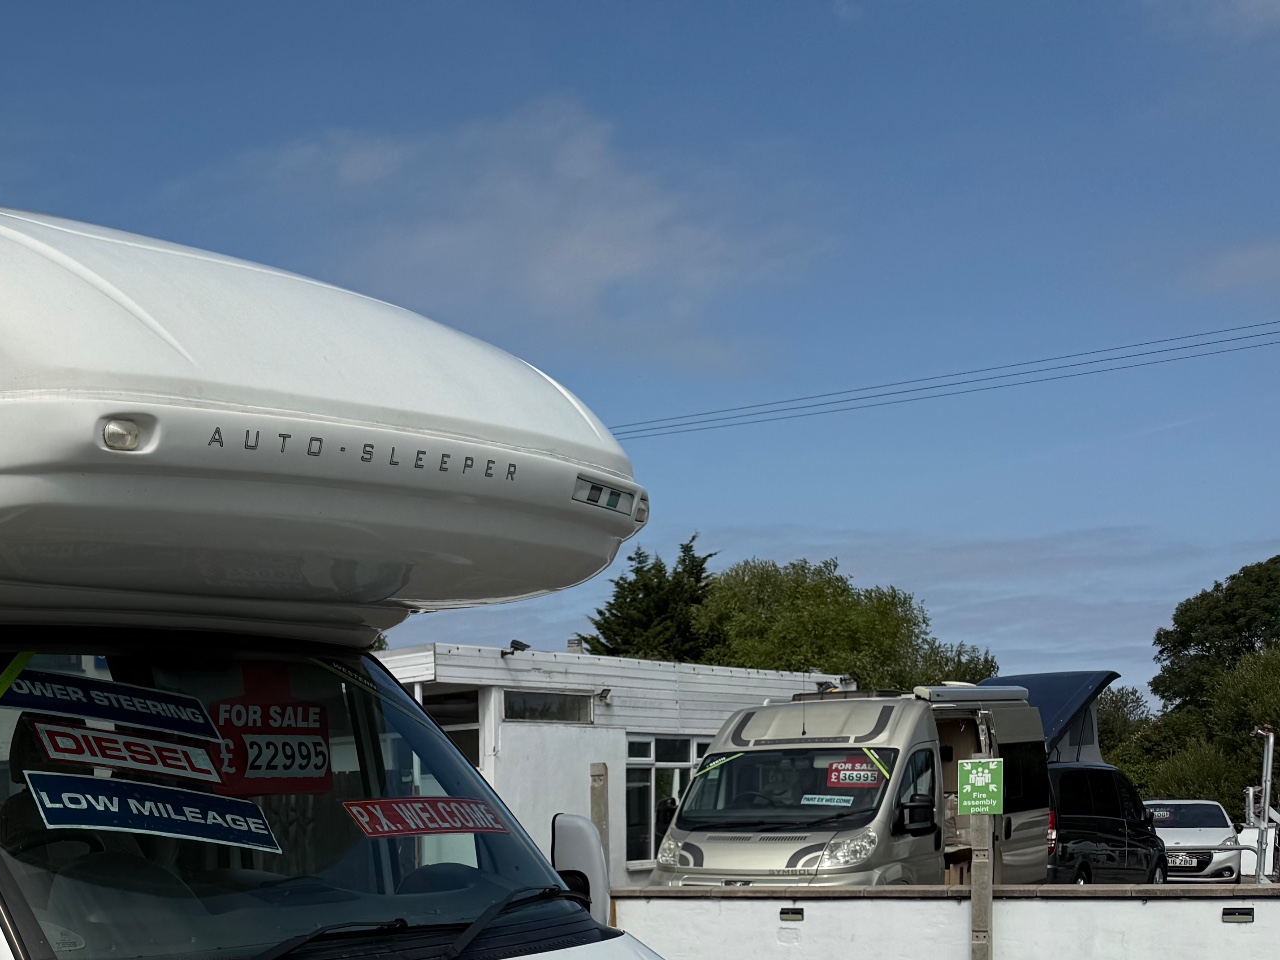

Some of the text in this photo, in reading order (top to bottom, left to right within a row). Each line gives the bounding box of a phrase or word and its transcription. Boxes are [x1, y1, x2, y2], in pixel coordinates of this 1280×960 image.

[11, 679, 205, 723] OWER STEERING
[219, 704, 321, 728] FOR SALE
[44, 729, 214, 776] DIESEL
[220, 738, 327, 774] £ 22995
[831, 772, 876, 782] £ 36995
[38, 790, 269, 835] LOW MILEAGE
[393, 801, 503, 829] WELCOME
[970, 805, 989, 814] point
